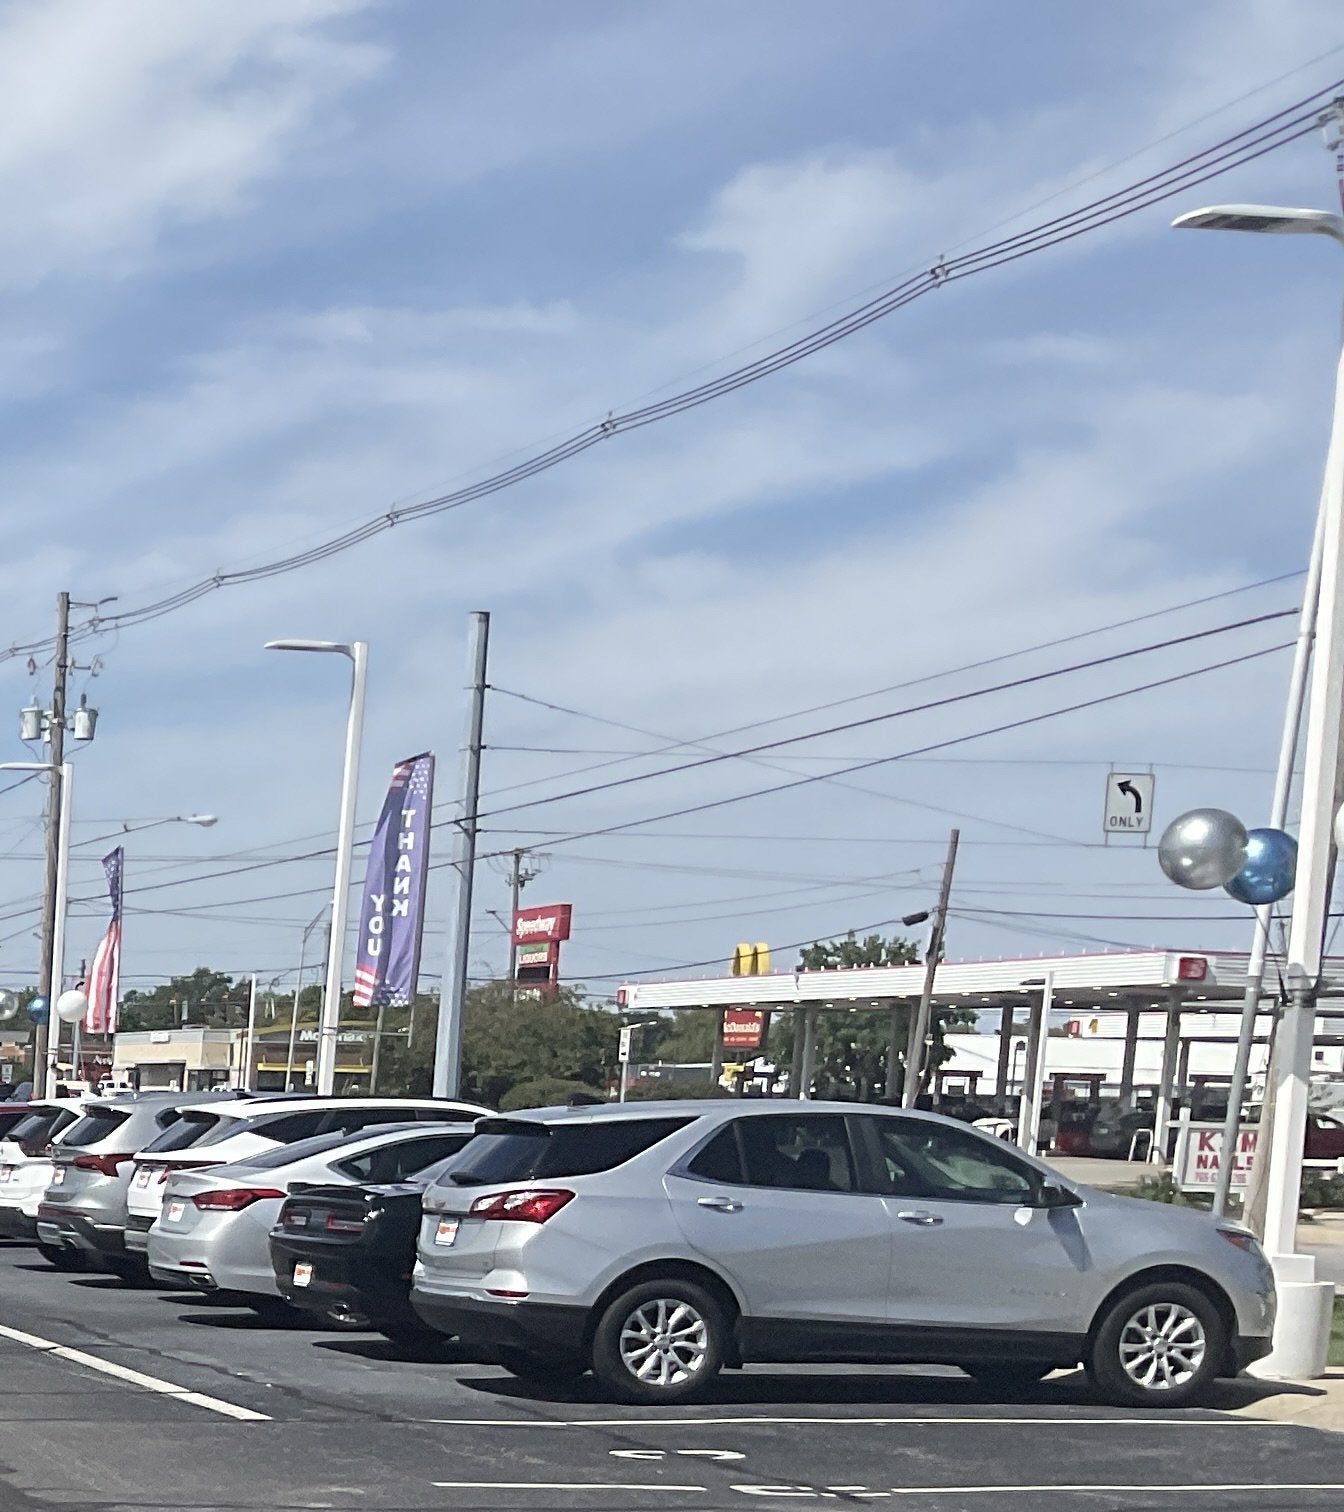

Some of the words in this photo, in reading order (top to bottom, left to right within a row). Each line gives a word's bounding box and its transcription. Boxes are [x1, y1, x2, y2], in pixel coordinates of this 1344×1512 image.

[1109, 815, 1144, 828] ONLY
[1198, 1131, 1258, 1153] KM
[1196, 1154, 1254, 1170] NALS
